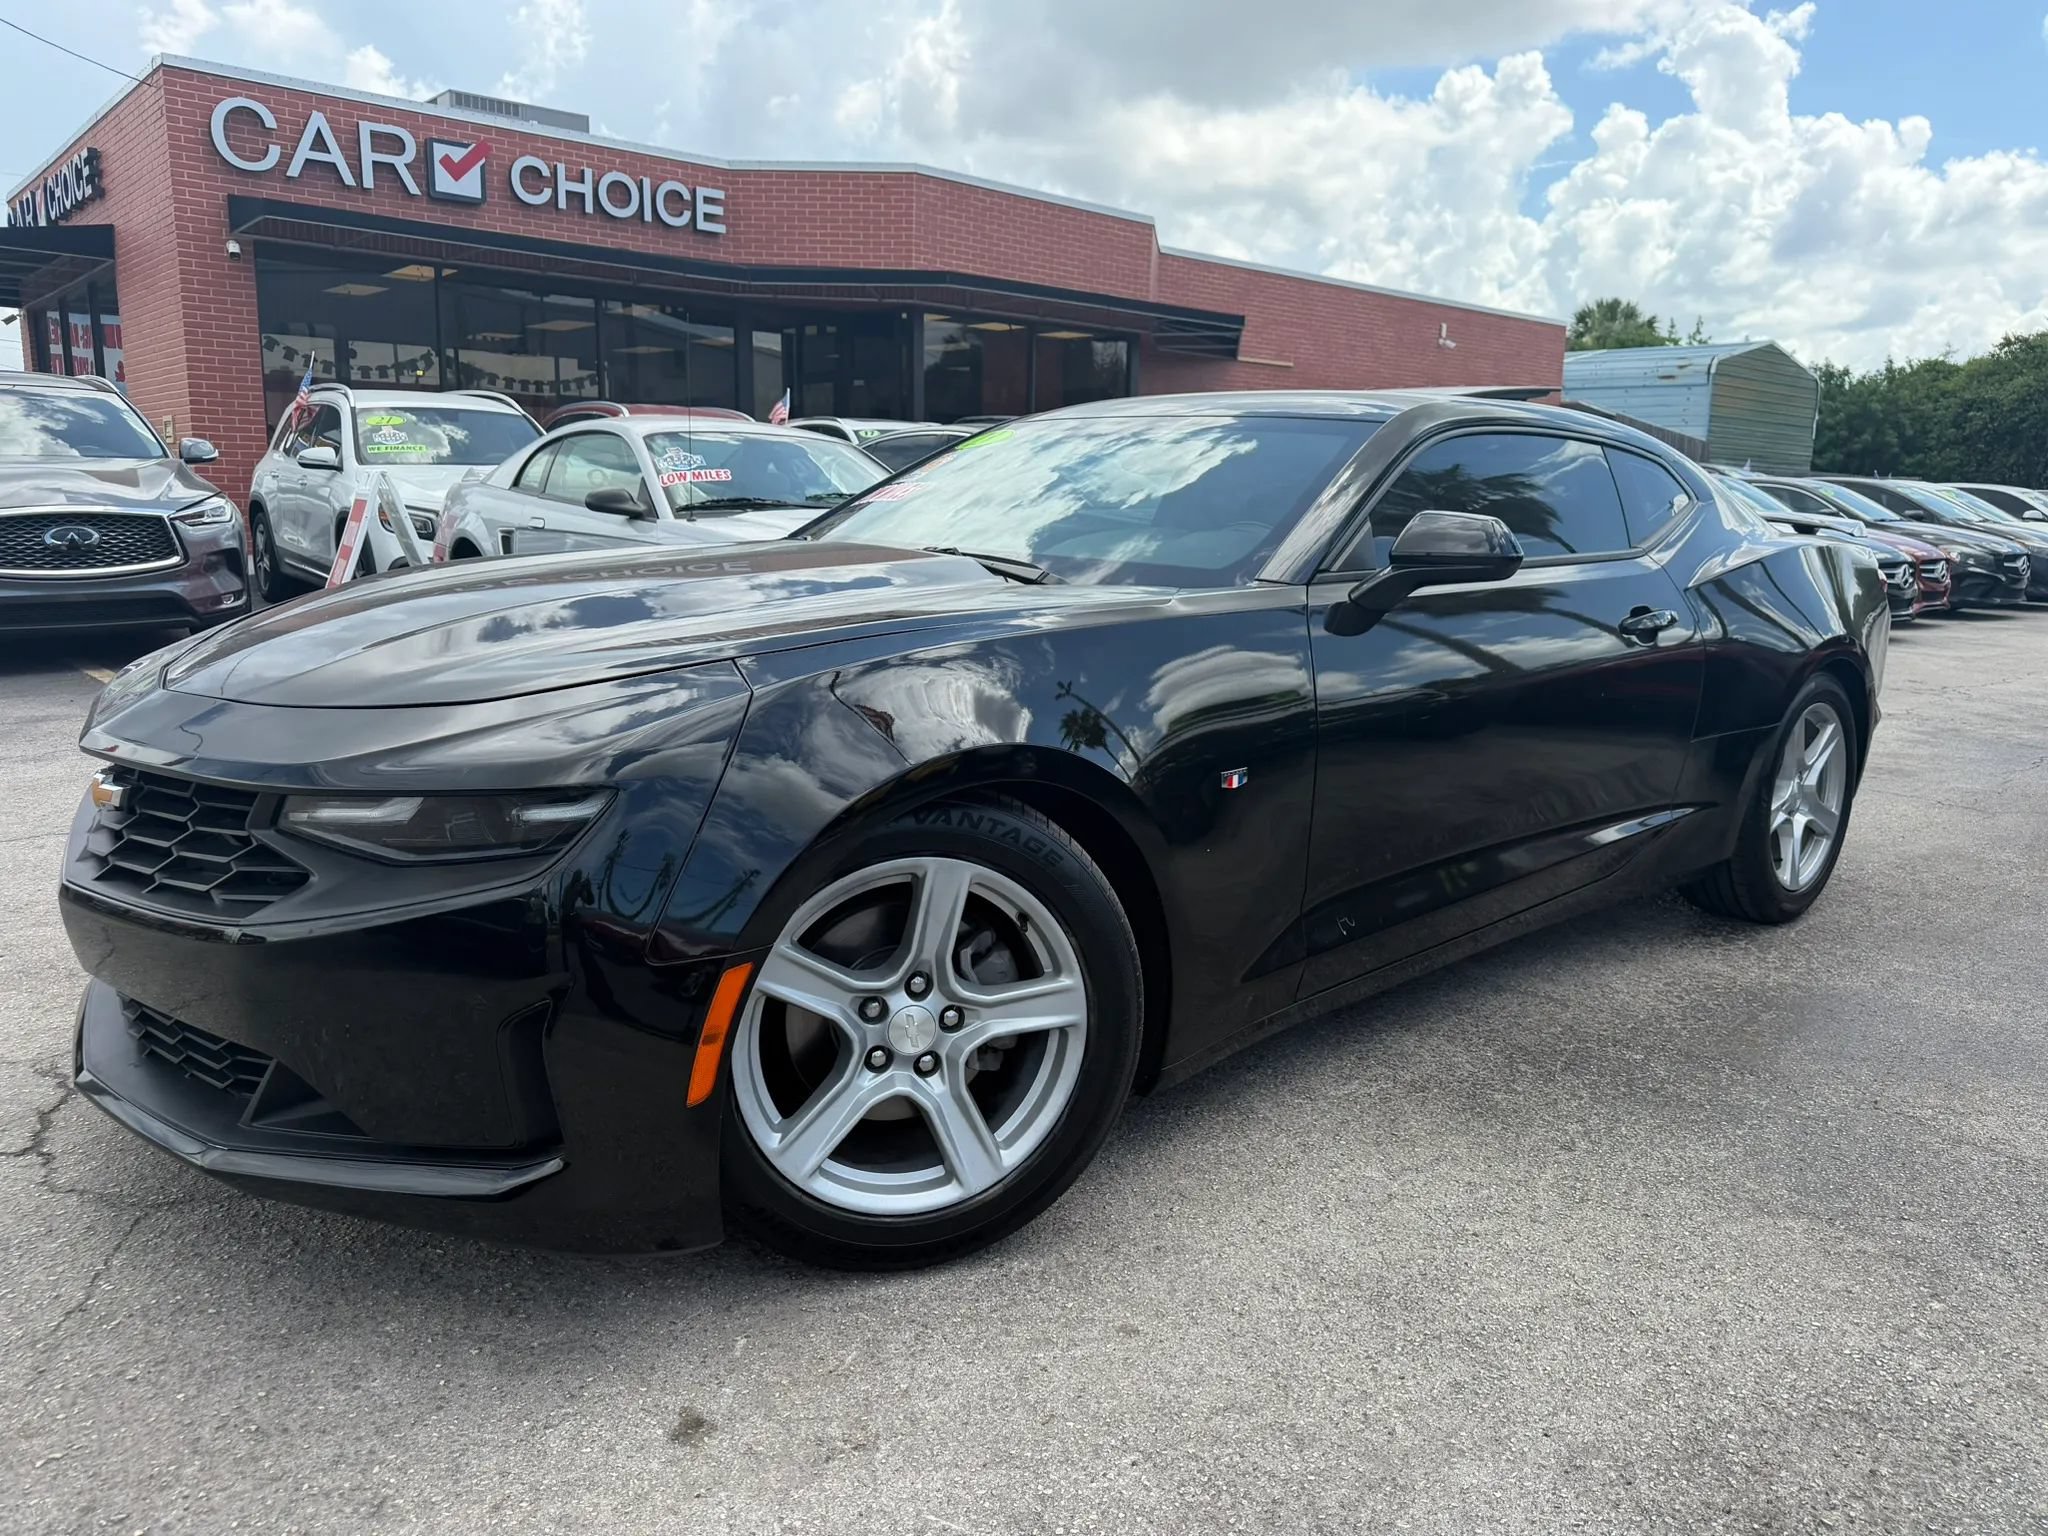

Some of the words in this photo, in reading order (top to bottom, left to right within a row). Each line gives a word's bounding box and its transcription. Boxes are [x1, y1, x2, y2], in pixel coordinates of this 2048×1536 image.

[46, 146, 93, 221] CHOICE
[210, 96, 422, 196] CAR
[509, 154, 728, 235] CHOICE
[660, 471, 688, 486] LOW
[692, 469, 731, 481] MILES
